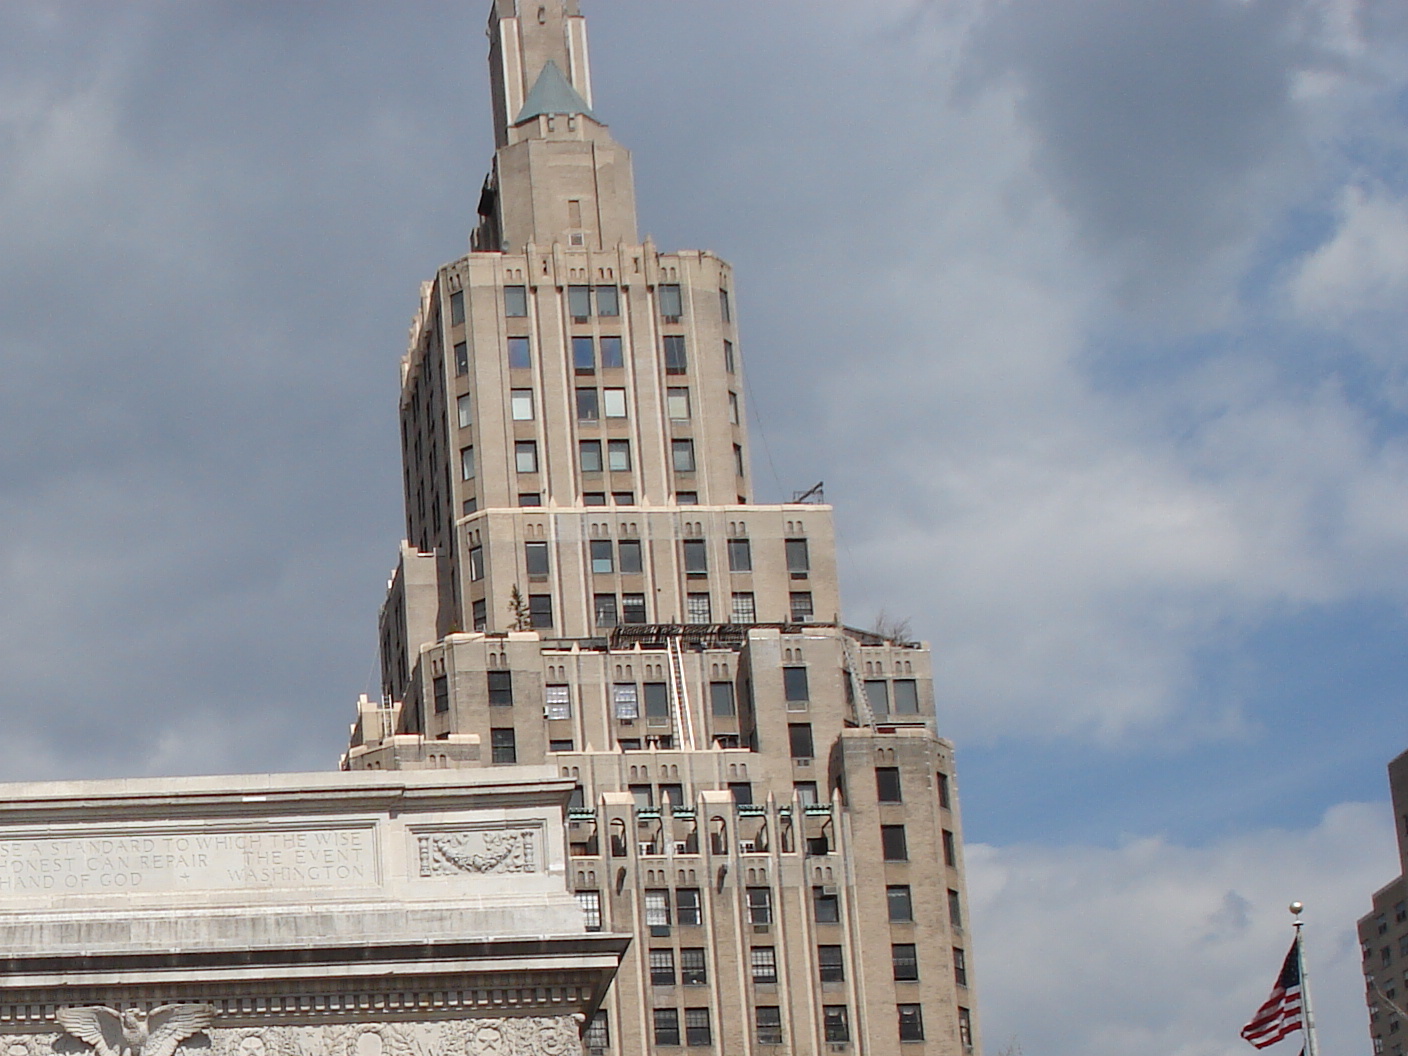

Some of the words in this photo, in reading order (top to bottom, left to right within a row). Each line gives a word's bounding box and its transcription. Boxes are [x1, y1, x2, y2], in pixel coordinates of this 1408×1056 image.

[31, 843, 42, 856] A
[51, 839, 154, 856] STANDARD
[162, 838, 189, 852] TO
[196, 835, 261, 850] WHICH
[269, 834, 307, 847] THE
[314, 832, 362, 846] WISE
[87, 856, 129, 871] CAN
[140, 854, 208, 869] REPAIR
[243, 851, 282, 866] THE
[295, 848, 362, 864] EVENT
[0, 875, 54, 890] HAND
[65, 874, 90, 888] OF
[100, 872, 142, 886] GOD
[227, 865, 364, 882] WASHINGTON
